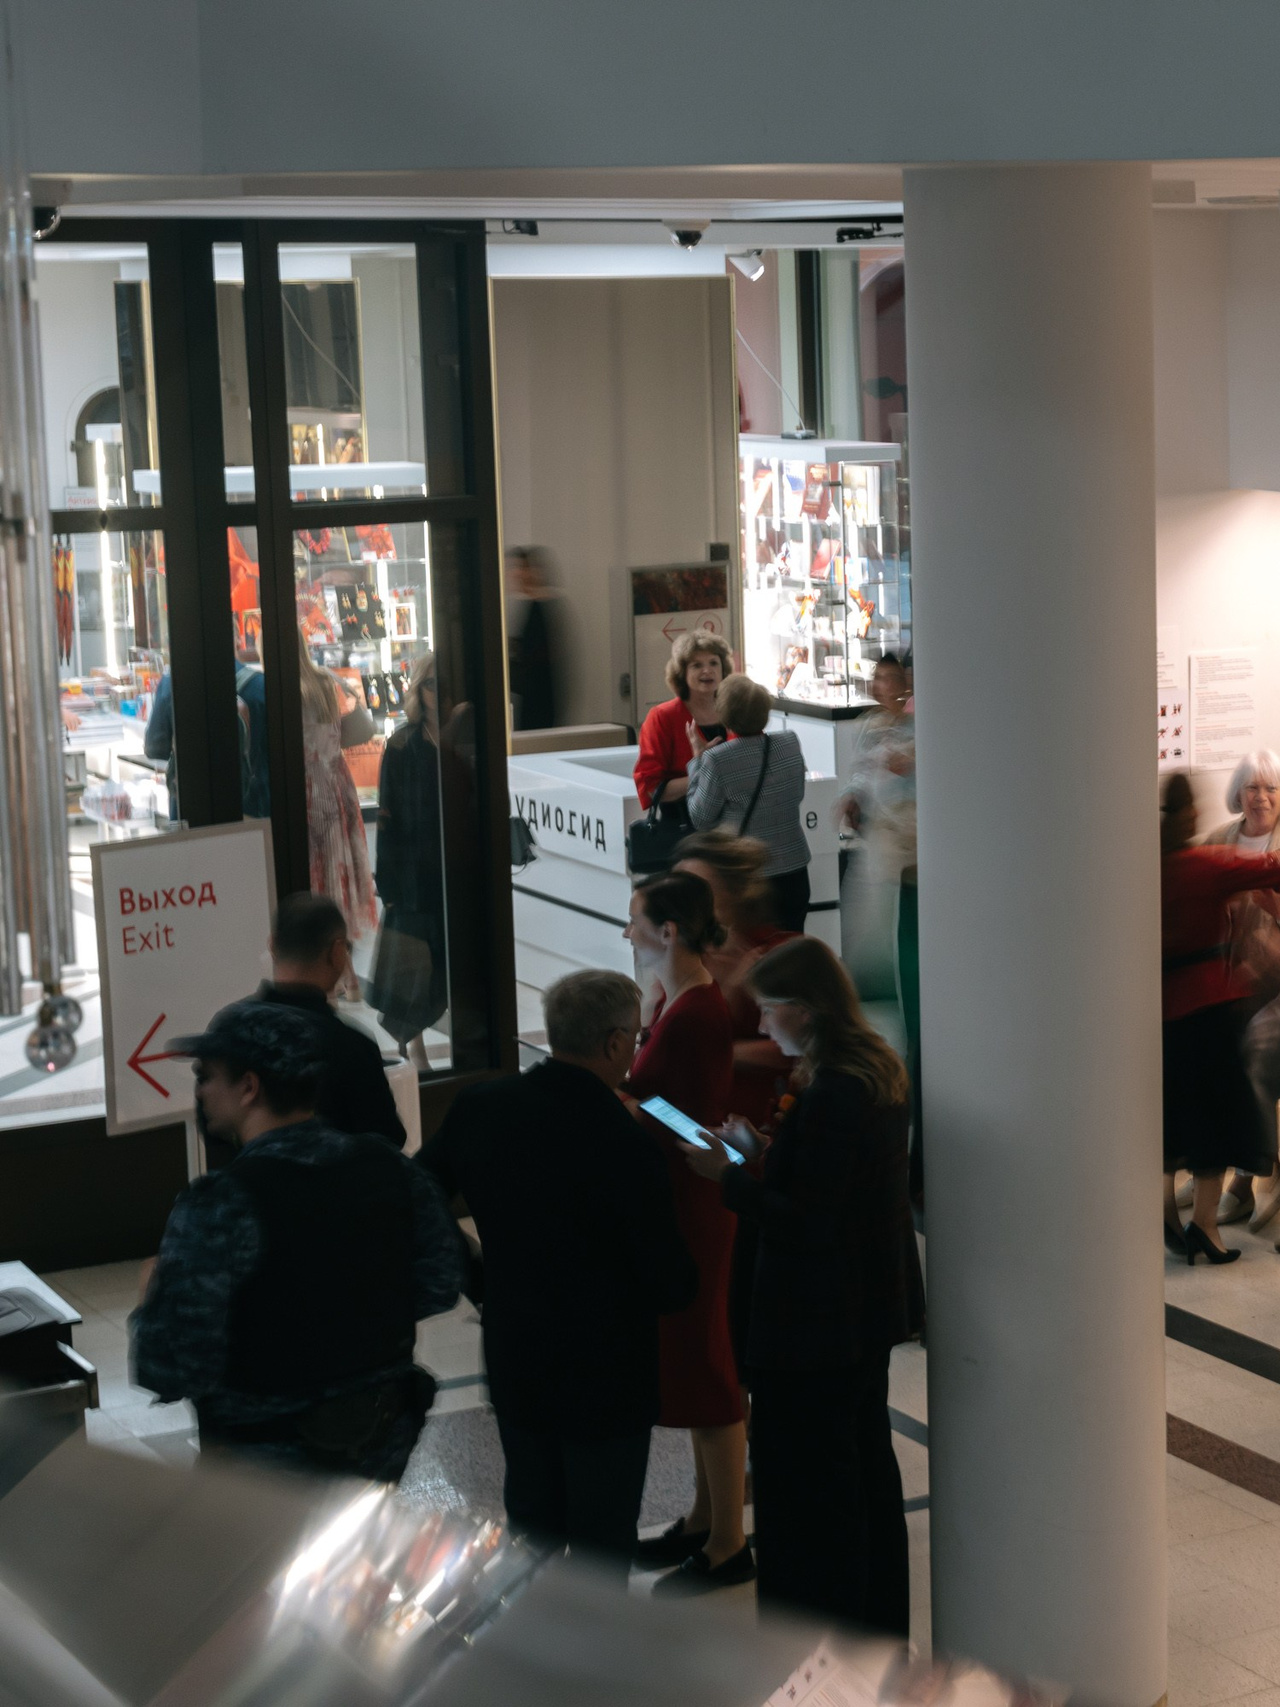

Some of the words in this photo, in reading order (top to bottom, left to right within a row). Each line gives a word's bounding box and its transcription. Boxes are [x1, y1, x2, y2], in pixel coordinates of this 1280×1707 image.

[515, 794, 606, 852] УДИОГИД
[119, 882, 217, 916] Выход
[122, 922, 175, 955] Exit
